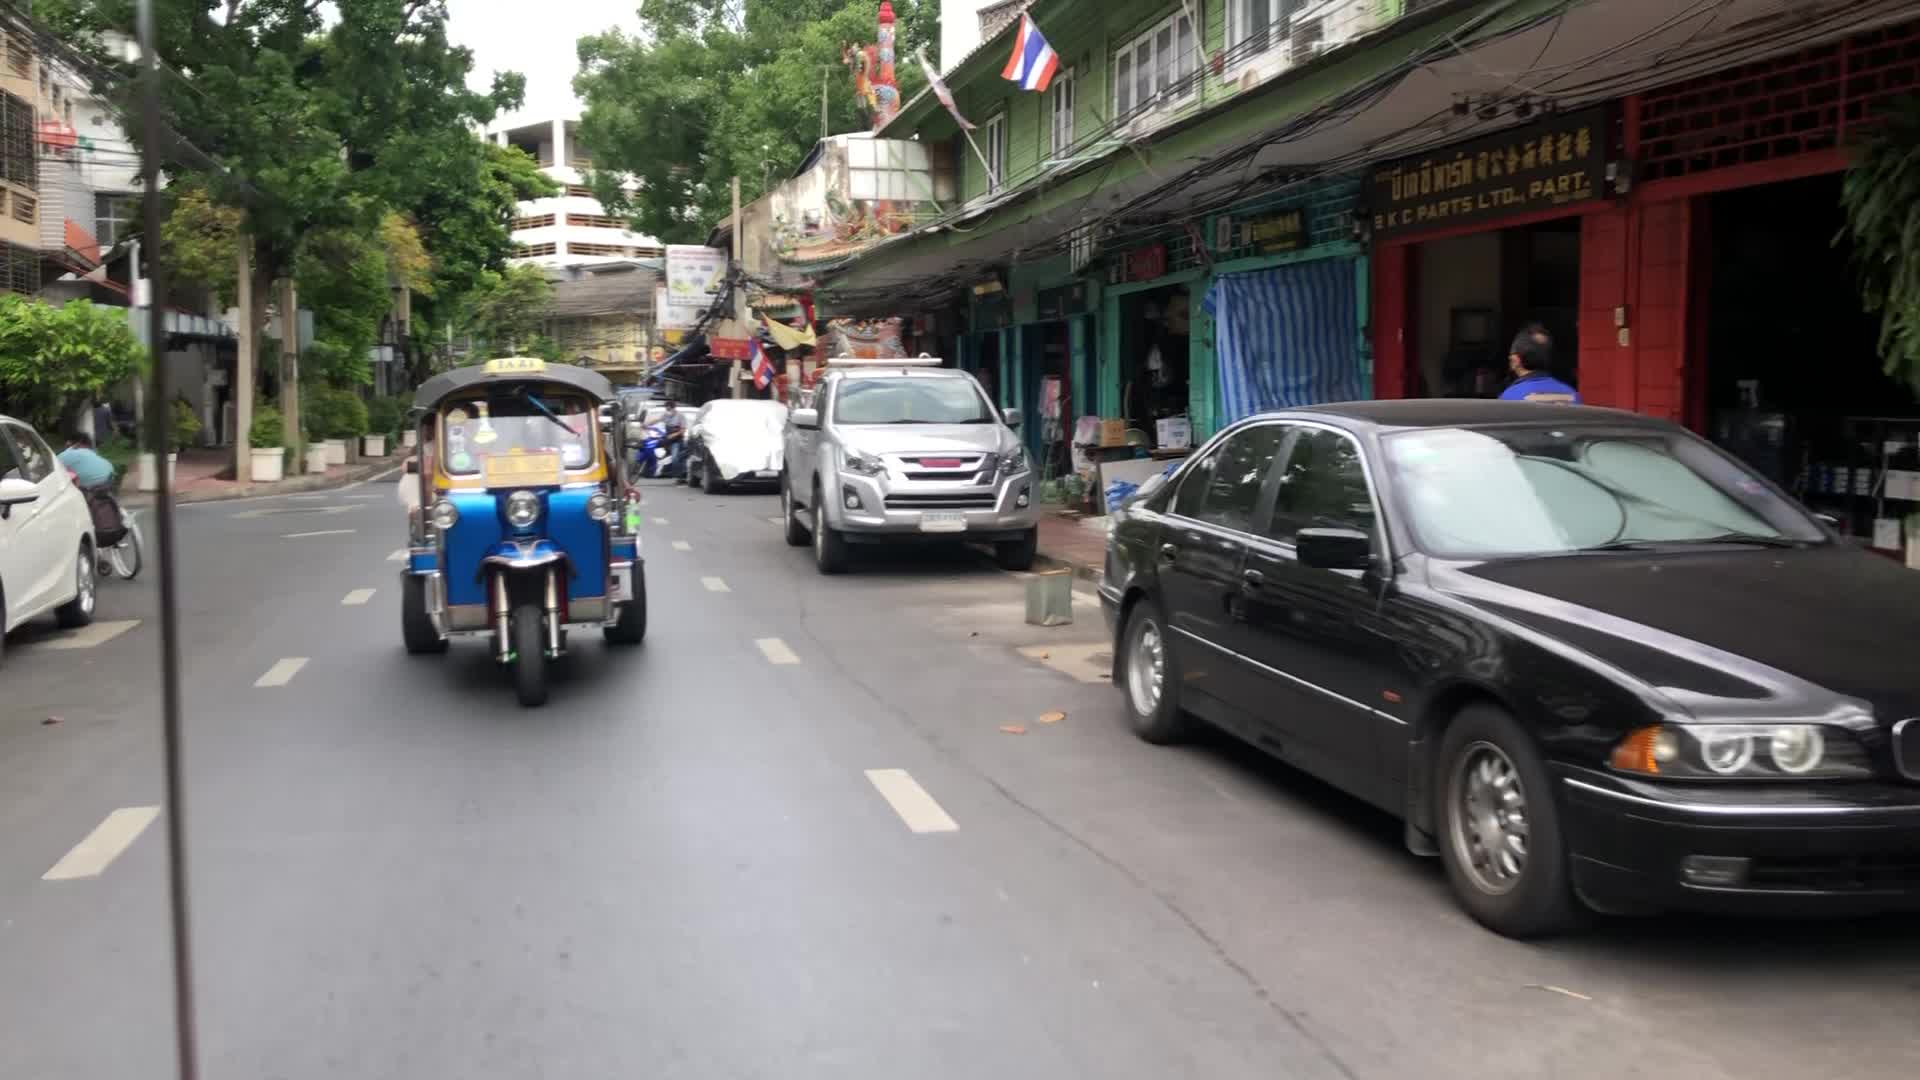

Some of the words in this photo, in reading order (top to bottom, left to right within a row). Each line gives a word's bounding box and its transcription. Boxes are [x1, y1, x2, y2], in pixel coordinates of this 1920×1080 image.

[1388, 212, 1399, 226] K
[1402, 209, 1414, 225] C
[1416, 195, 1473, 221] PARTS
